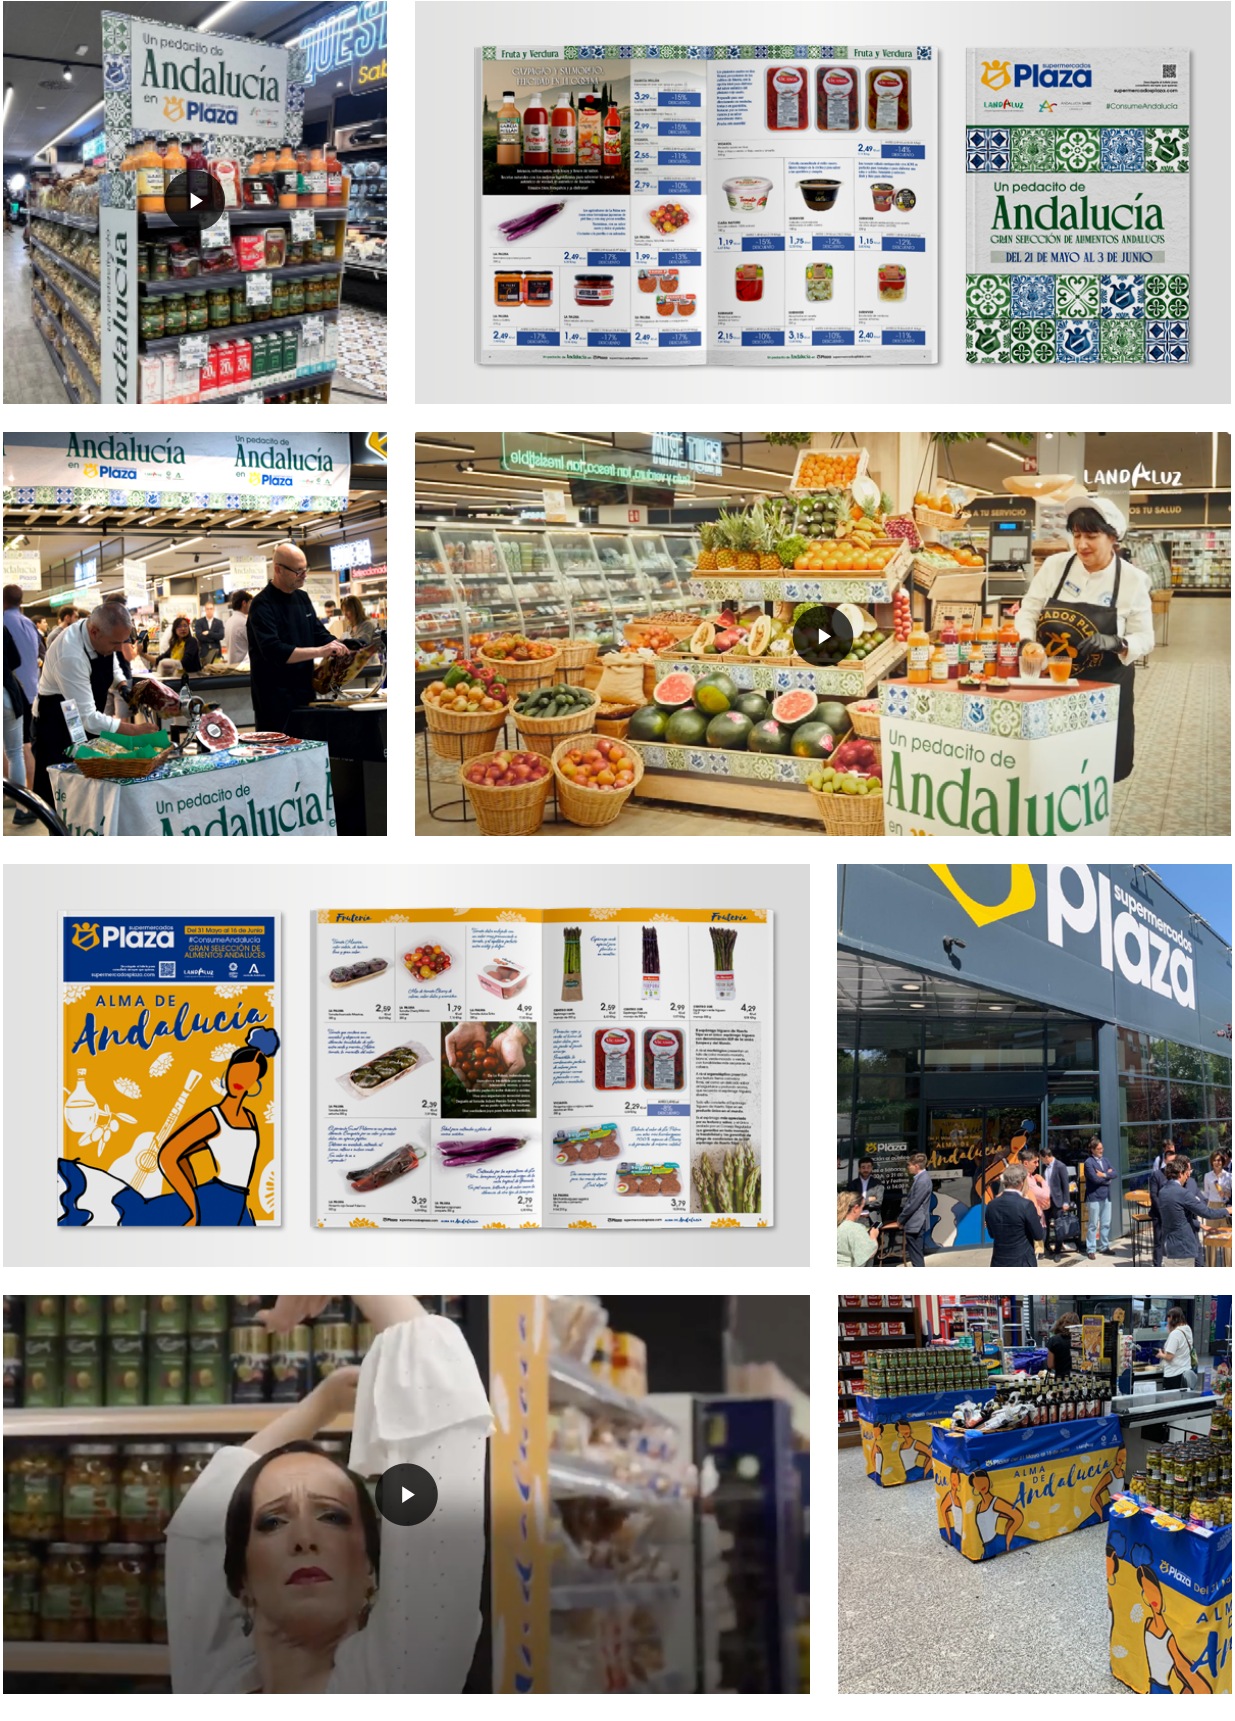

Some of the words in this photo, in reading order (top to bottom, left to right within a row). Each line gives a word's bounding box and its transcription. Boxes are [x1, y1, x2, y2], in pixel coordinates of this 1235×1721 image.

[142, 33, 158, 48] Un
[160, 36, 207, 55] pedacito
[209, 42, 224, 56] de
[301, 2, 387, 87] QUES
[501, 50, 521, 59] Fruta
[522, 52, 527, 60] y
[528, 50, 559, 59] Verdura
[854, 48, 874, 58] Fruta
[875, 50, 880, 59] y
[882, 48, 913, 58] Verdura
[141, 48, 280, 103] Andalucía
[1014, 64, 1092, 88] Plaza
[144, 94, 158, 105] en
[186, 100, 238, 125] Plaza
[983, 99, 1024, 109] LANDALUZ
[1106, 102, 1178, 110] #ConsumeAndalucía
[858, 144, 873, 153] 2,49
[994, 182, 1009, 192] Un
[1012, 182, 1066, 194] pedacito
[1070, 182, 1086, 192] de
[991, 193, 1165, 230] Andalucía
[991, 235, 1013, 244] GRAN
[1016, 233, 1061, 244] SELECCIÓN
[1064, 235, 1073, 244] DE
[1076, 235, 1119, 244] ALIMENTOS
[1122, 235, 1165, 244] ANDALUCES
[564, 252, 579, 261] 2,49
[635, 252, 650, 261] 1,99
[1006, 252, 1022, 262] DEL
[1025, 252, 1033, 262] 21
[1037, 252, 1048, 262] DE
[1051, 252, 1080, 262] MAYO
[1083, 252, 1095, 262] AL
[1098, 252, 1104, 262] 3
[1107, 252, 1118, 262] DE
[1121, 252, 1153, 263] JUNIO
[493, 331, 508, 340] 2,49
[635, 332, 650, 341] 2,49
[235, 435, 246, 444] Un
[246, 436, 277, 447] pedacito
[66, 433, 185, 464] Andalucía
[235, 444, 334, 472] Andalucía
[99, 466, 137, 480] Plaza
[261, 475, 293, 487] Plaza
[991, 508, 1027, 517] SERVICIO
[1142, 507, 1153, 515] TU
[1154, 505, 1182, 514] SALUD
[889, 728, 907, 748] Un
[911, 733, 985, 765] pedacito
[990, 746, 1016, 770] de
[55, 789, 66, 803] de
[886, 751, 1109, 836] Andalucía
[156, 800, 174, 815] Un
[177, 790, 229, 811] pedacito
[231, 785, 251, 802] de
[889, 818, 903, 835] en
[1114, 884, 1193, 953] supermercados
[206, 927, 222, 935] Mayo
[103, 926, 174, 948] Plaza
[189, 936, 260, 944] #ConsumeAndalucía
[1047, 864, 1196, 1011] plaza
[209, 944, 248, 952] SELECCIÓN
[96, 995, 146, 1007] ALMA
[155, 995, 176, 1007] DE
[375, 1004, 391, 1012] 2,59
[447, 1003, 462, 1012] 1,79
[517, 1004, 532, 1012] 4,99
[600, 1003, 616, 1011] 2,59
[670, 1003, 685, 1011] 2,99
[741, 1004, 756, 1012] 4,29
[71, 1002, 268, 1056] Andalucía
[421, 1100, 437, 1109] 2,39
[625, 1102, 640, 1110] 2,29
[877, 1142, 907, 1152] Plaza
[411, 1196, 427, 1205] 3,29
[671, 1199, 686, 1208] 3,79
[1014, 1466, 1046, 1478] ALMA
[1012, 1458, 1112, 1509] Andalucía
[1032, 1476, 1045, 1484] DE
[1168, 1566, 1192, 1587] Plaza
[1193, 1583, 1209, 1595] Del
